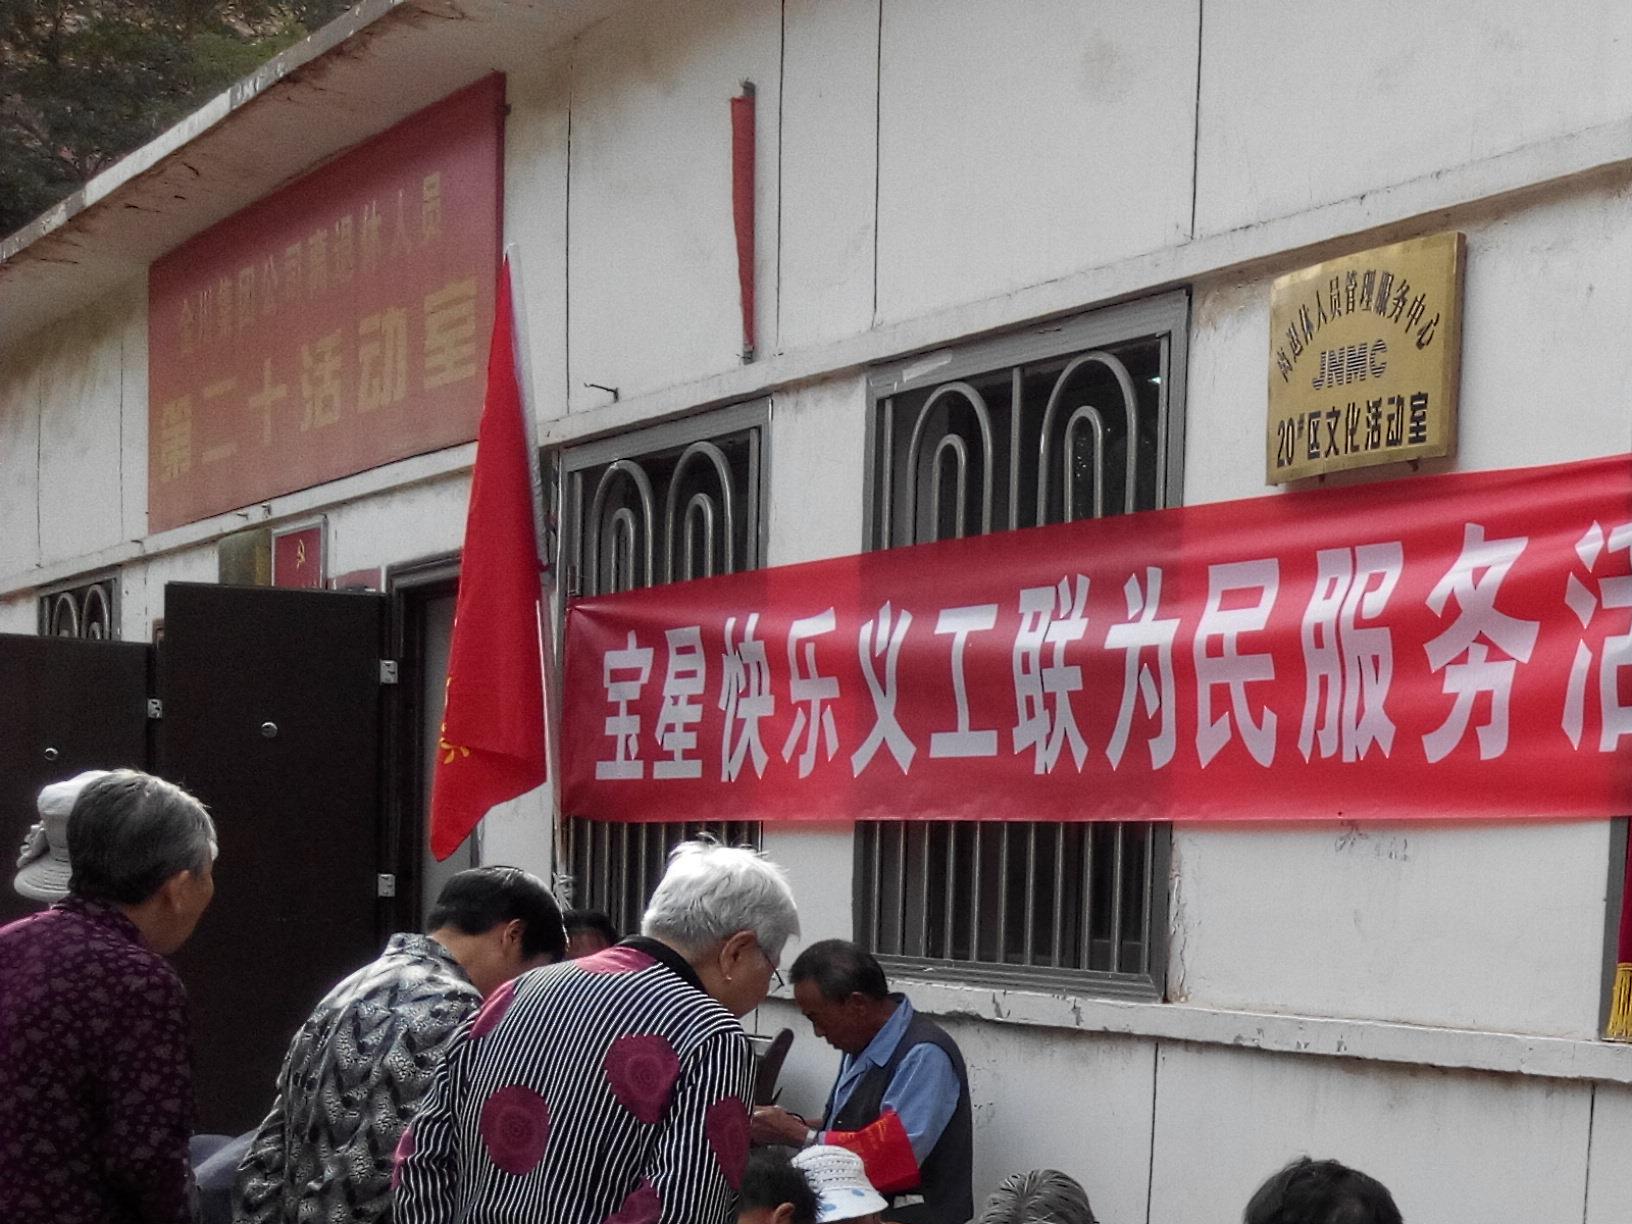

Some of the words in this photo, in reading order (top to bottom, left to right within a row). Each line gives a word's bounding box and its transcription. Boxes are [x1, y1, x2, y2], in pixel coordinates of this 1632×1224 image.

[160, 278, 477, 483] 第二十活动室
[1312, 339, 1388, 390] JNMC
